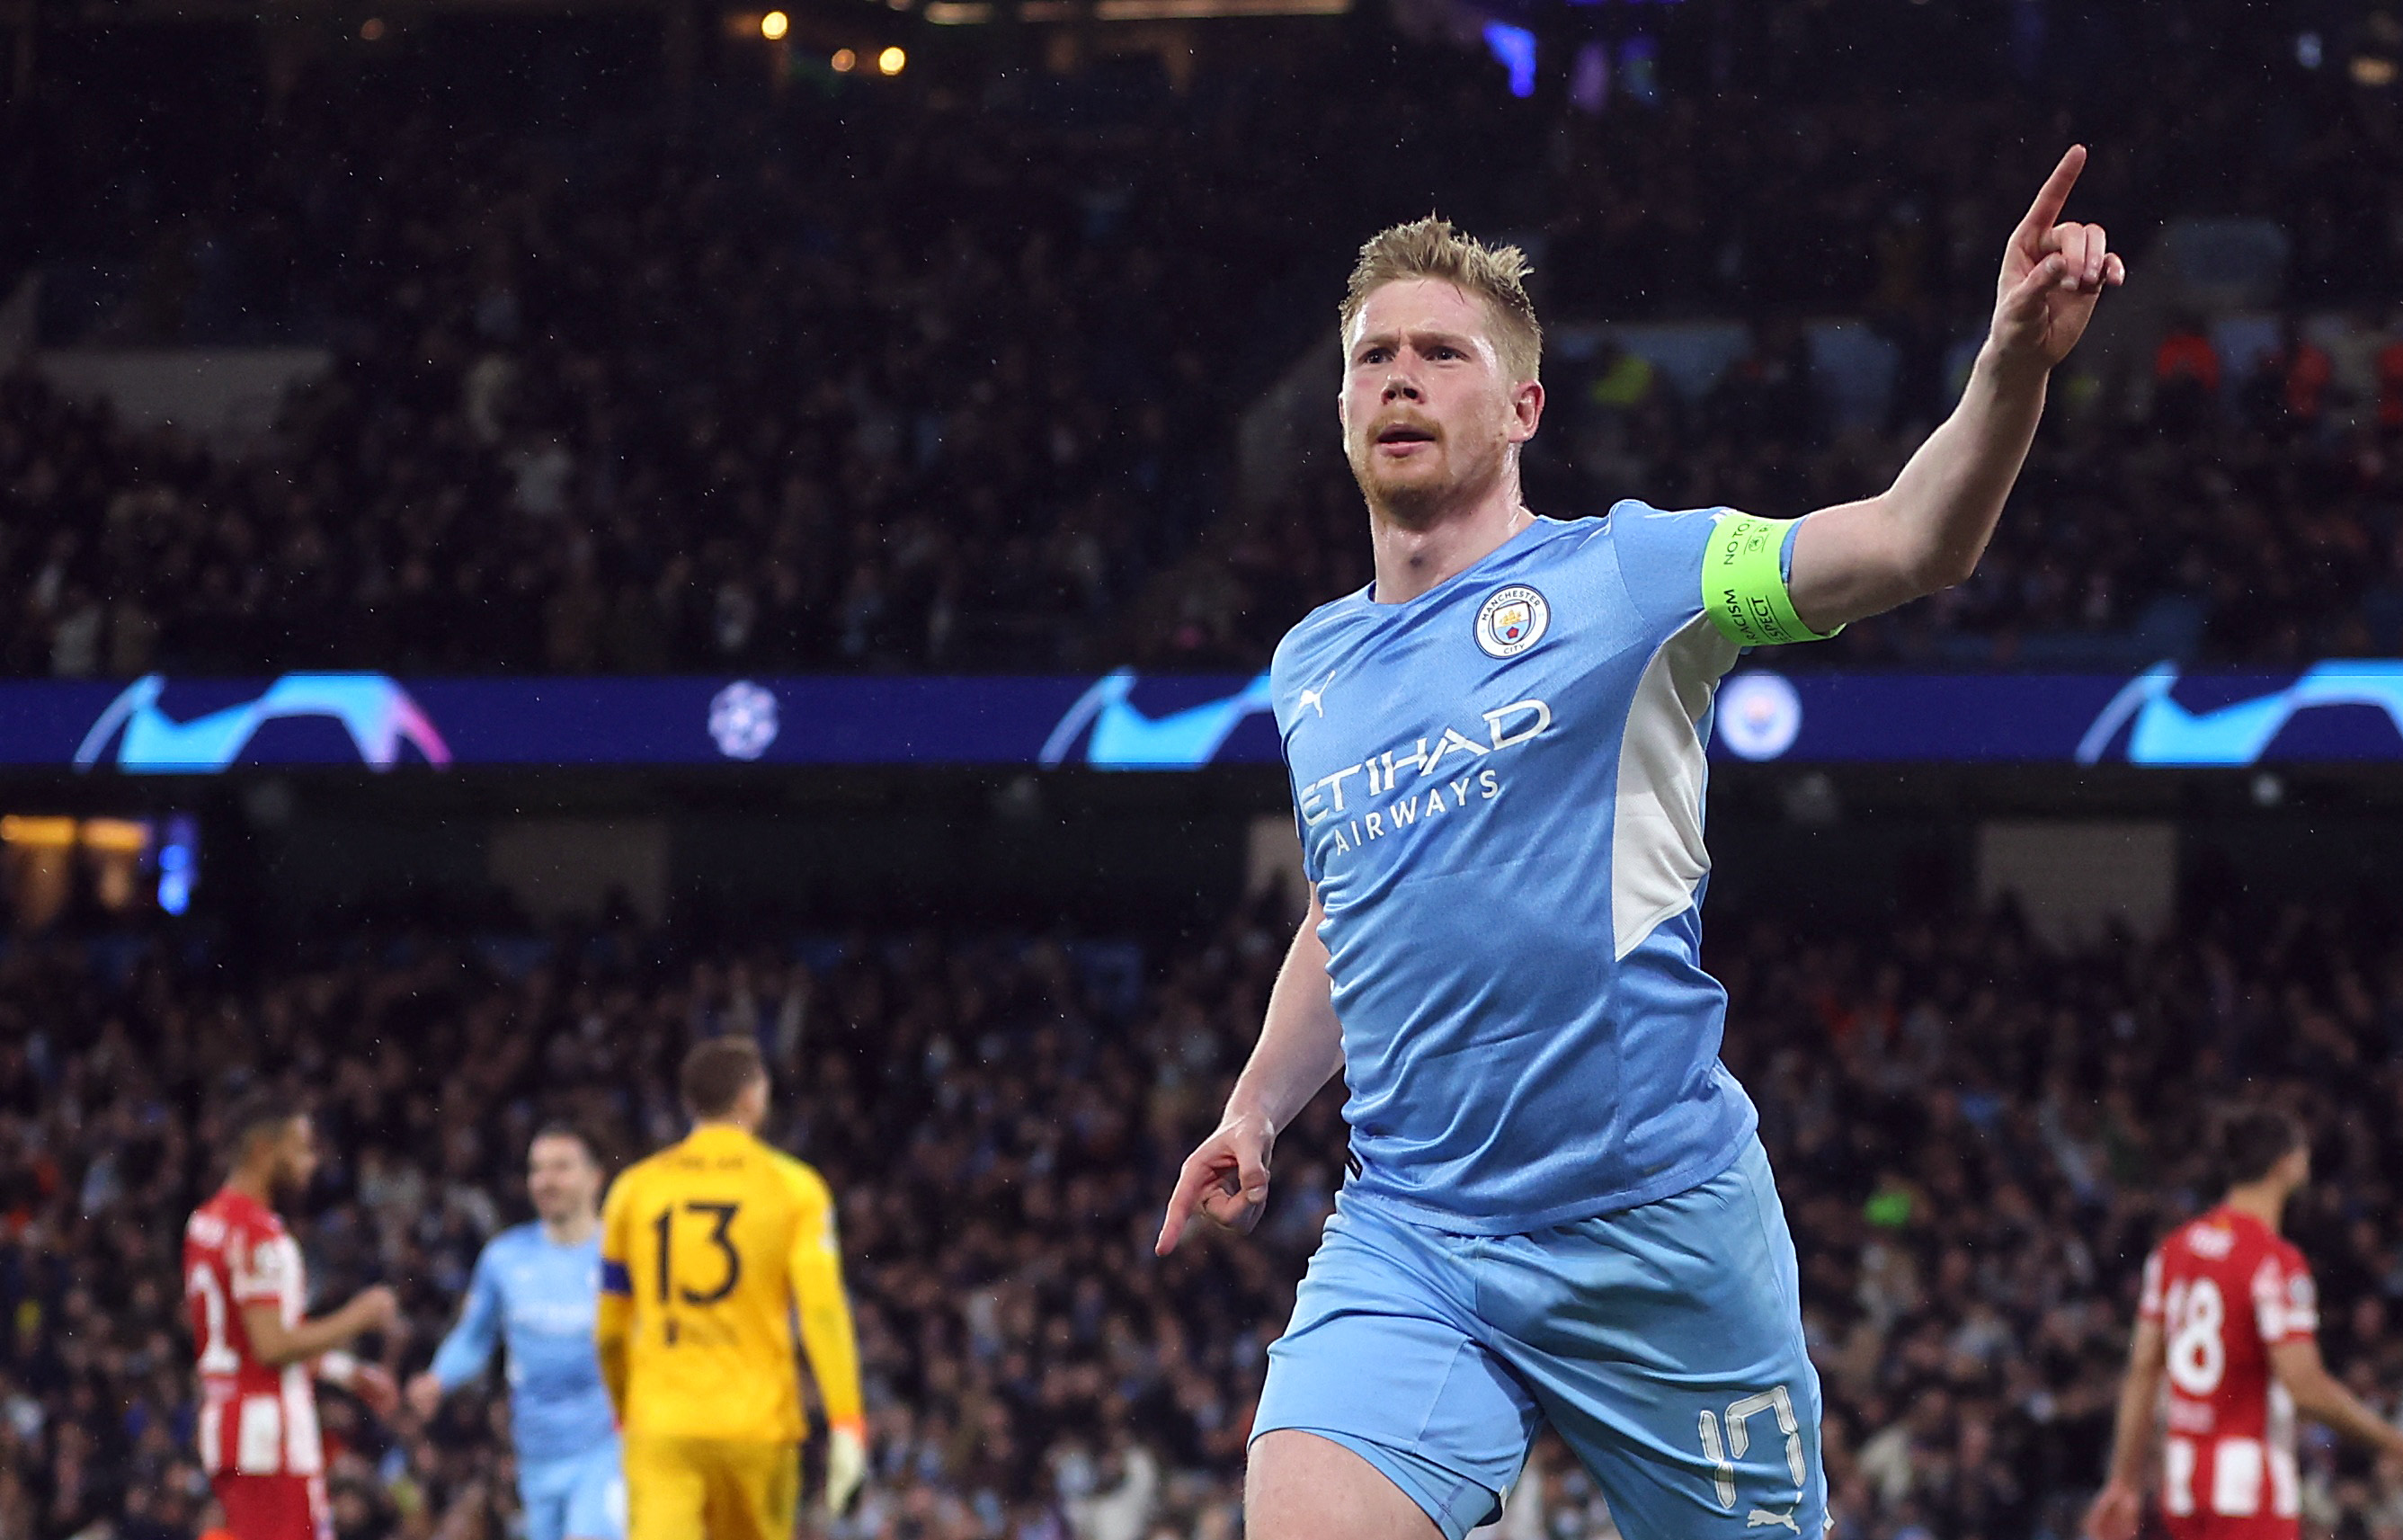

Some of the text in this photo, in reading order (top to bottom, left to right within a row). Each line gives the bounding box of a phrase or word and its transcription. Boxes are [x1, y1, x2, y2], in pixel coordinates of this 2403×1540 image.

[1723, 523, 1750, 565] NO TO
[1482, 590, 1541, 621] MANCHESTER
[1503, 643, 1526, 654] CITY
[1302, 699, 1552, 826] ETIHAD
[1334, 770, 1500, 856] AIRWAYS
[654, 1199, 741, 1307] 13
[2165, 1278, 2225, 1394] 18
[1698, 1385, 1806, 1509] 17
